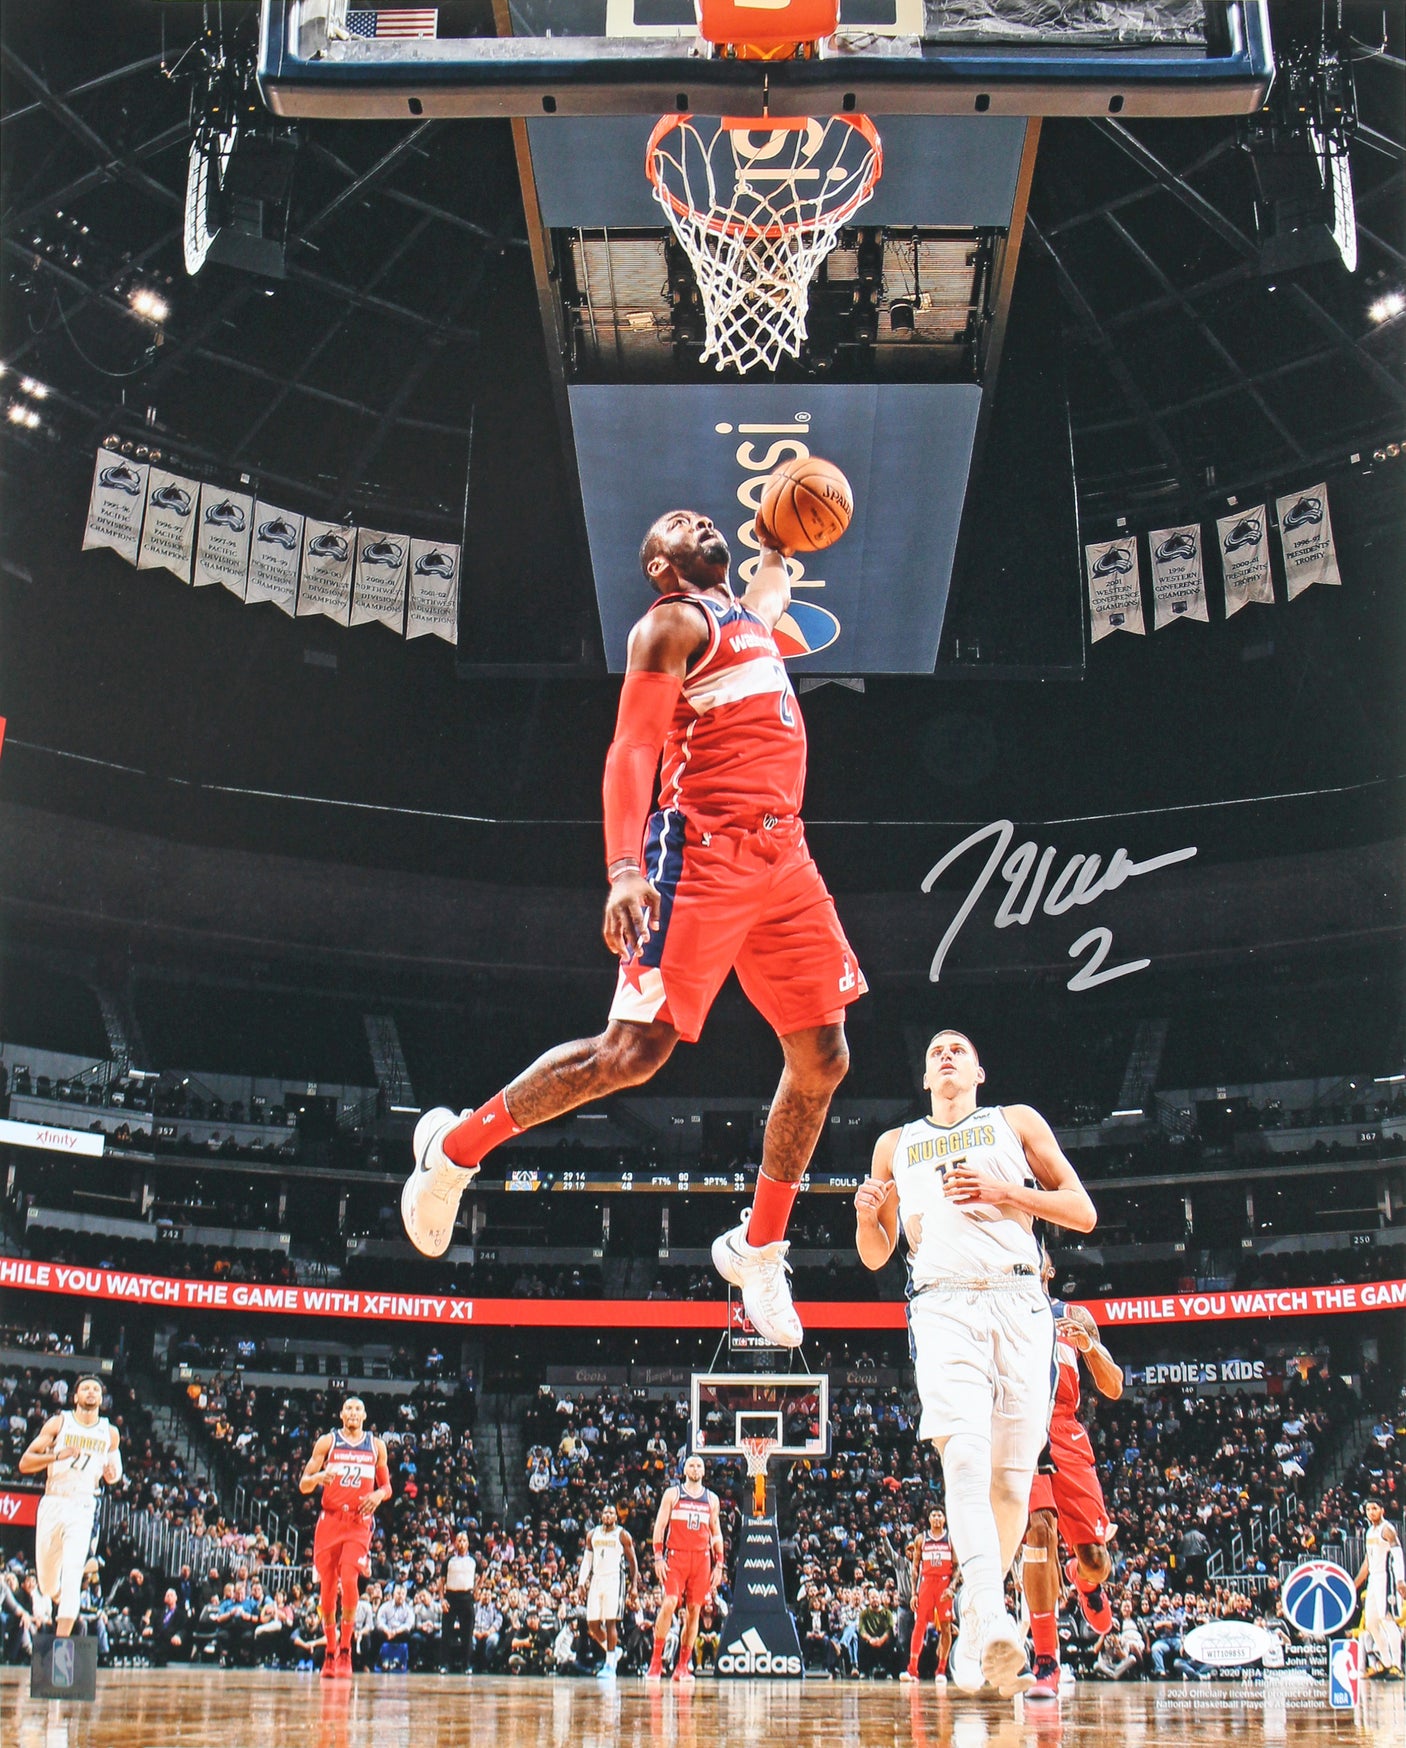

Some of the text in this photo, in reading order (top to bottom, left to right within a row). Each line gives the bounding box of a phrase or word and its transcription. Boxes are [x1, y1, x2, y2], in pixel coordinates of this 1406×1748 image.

[100, 508, 131, 522] PACIFIC
[97, 516, 132, 532] DIVISION
[90, 523, 137, 543] CHAMPIONS
[153, 528, 184, 541] PACIFIC
[150, 536, 184, 551] DIVISION
[144, 543, 189, 561] CHAMPIONS
[207, 544, 238, 557] PACIFIC
[204, 552, 240, 567] DIVISION
[1295, 551, 1325, 566] TROPHY
[199, 558, 244, 577] CHAMPIONS
[251, 560, 298, 577] NORTHWEST
[1168, 566, 1186, 574] 1996
[257, 570, 292, 585] DIVISION
[303, 574, 350, 589] NORTHWEST
[1106, 578, 1122, 587] 2001
[1158, 572, 1197, 583] WESTERN
[1234, 574, 1262, 587] TROPHY
[250, 578, 295, 596] CHAMPIONS
[308, 584, 343, 597] DIVISION
[355, 582, 403, 597] NORTHWEST
[1095, 585, 1133, 596] WESTERN
[1154, 579, 1202, 591] CONFERENCE
[302, 592, 347, 607] CHAMPIONS
[361, 592, 397, 604] DIVISION
[1091, 591, 1139, 605] CONFERENCE
[1157, 587, 1201, 600] CHAMPIONS
[356, 600, 401, 613] CHAMPIONS
[411, 596, 456, 608] NORTHWEST
[1095, 599, 1138, 612] CHAMPIONS
[417, 605, 451, 615] DIVISION
[411, 614, 456, 625] CHAMPIONS
[1066, 926, 1152, 991] 2
[36, 1130, 77, 1148] xfinity
[1360, 1132, 1376, 1141] 367
[906, 1125, 996, 1167] NUGGETS
[651, 1177, 671, 1186] FT%
[704, 1177, 728, 1186] 3PT%
[734, 1183, 745, 1191] 33
[829, 1178, 858, 1187] FOULS
[162, 1230, 179, 1239] 242
[1353, 1236, 1371, 1245] 250
[0, 1260, 473, 1319] HILE YOU WATCH THE GAME WITH XFINITY X1
[1105, 1299, 1176, 1320] WHILE
[1179, 1296, 1227, 1316] YOU
[1230, 1291, 1308, 1313] WATCH
[1312, 1288, 1356, 1309] THE
[576, 1369, 607, 1382] Coors
[846, 1371, 878, 1384] Coors
[1221, 1360, 1265, 1382] KIDS
[340, 1465, 362, 1488] 22
[687, 1513, 700, 1530] 13
[746, 1534, 773, 1545] AVAYA
[743, 1558, 775, 1571] AVAYA
[930, 1552, 942, 1567] 12
[747, 1583, 778, 1598] VAYA
[718, 1650, 801, 1674] adidas
